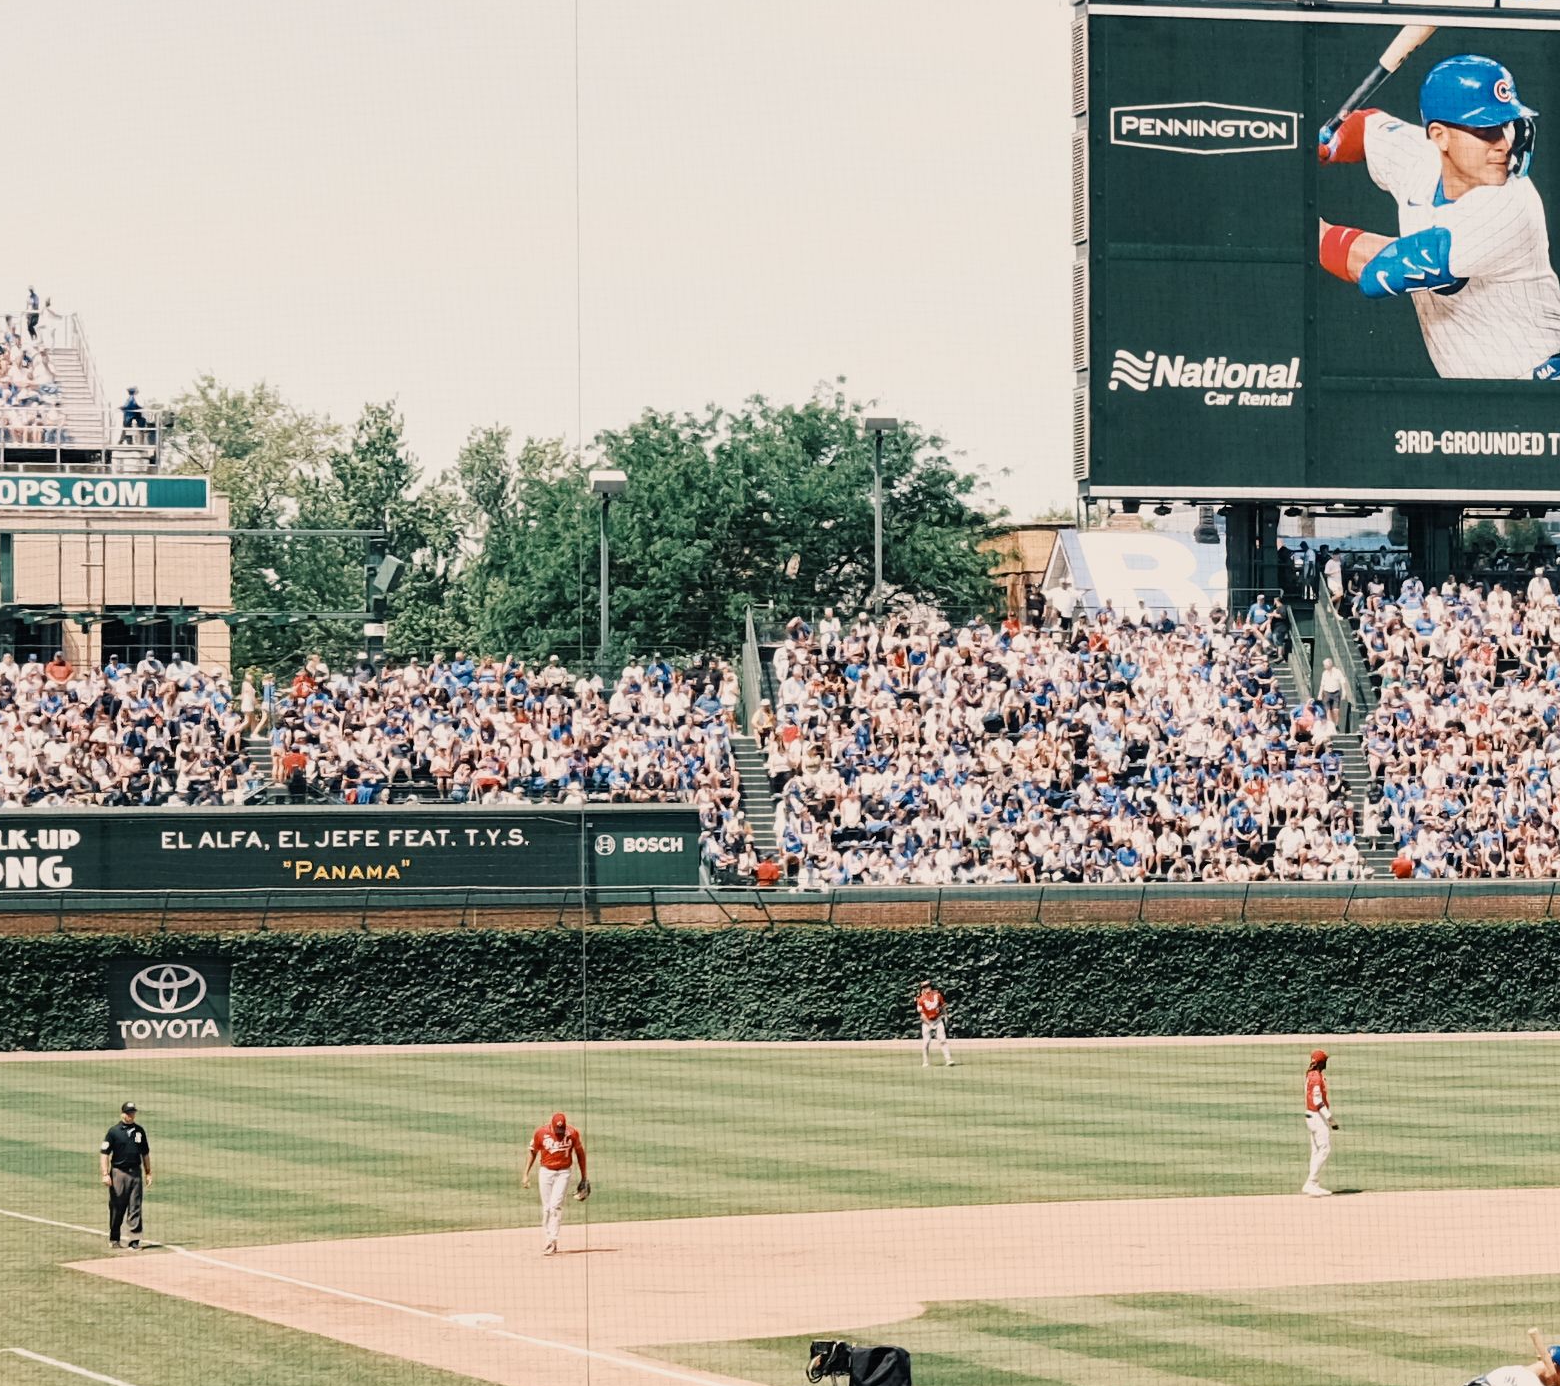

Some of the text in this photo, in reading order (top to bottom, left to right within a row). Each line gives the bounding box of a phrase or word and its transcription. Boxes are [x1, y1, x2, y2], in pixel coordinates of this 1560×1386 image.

[1121, 116, 1288, 140] PENNINGTON
[1205, 391, 1293, 406] Car Rental
[1395, 430, 1544, 455] 3RD-GROUNDED
[162, 829, 529, 850] EL ALFA, EL JEFE FEAT. T.Y.S.
[624, 837, 682, 852] BOSCH
[117, 1019, 219, 1040] TOYOTA
